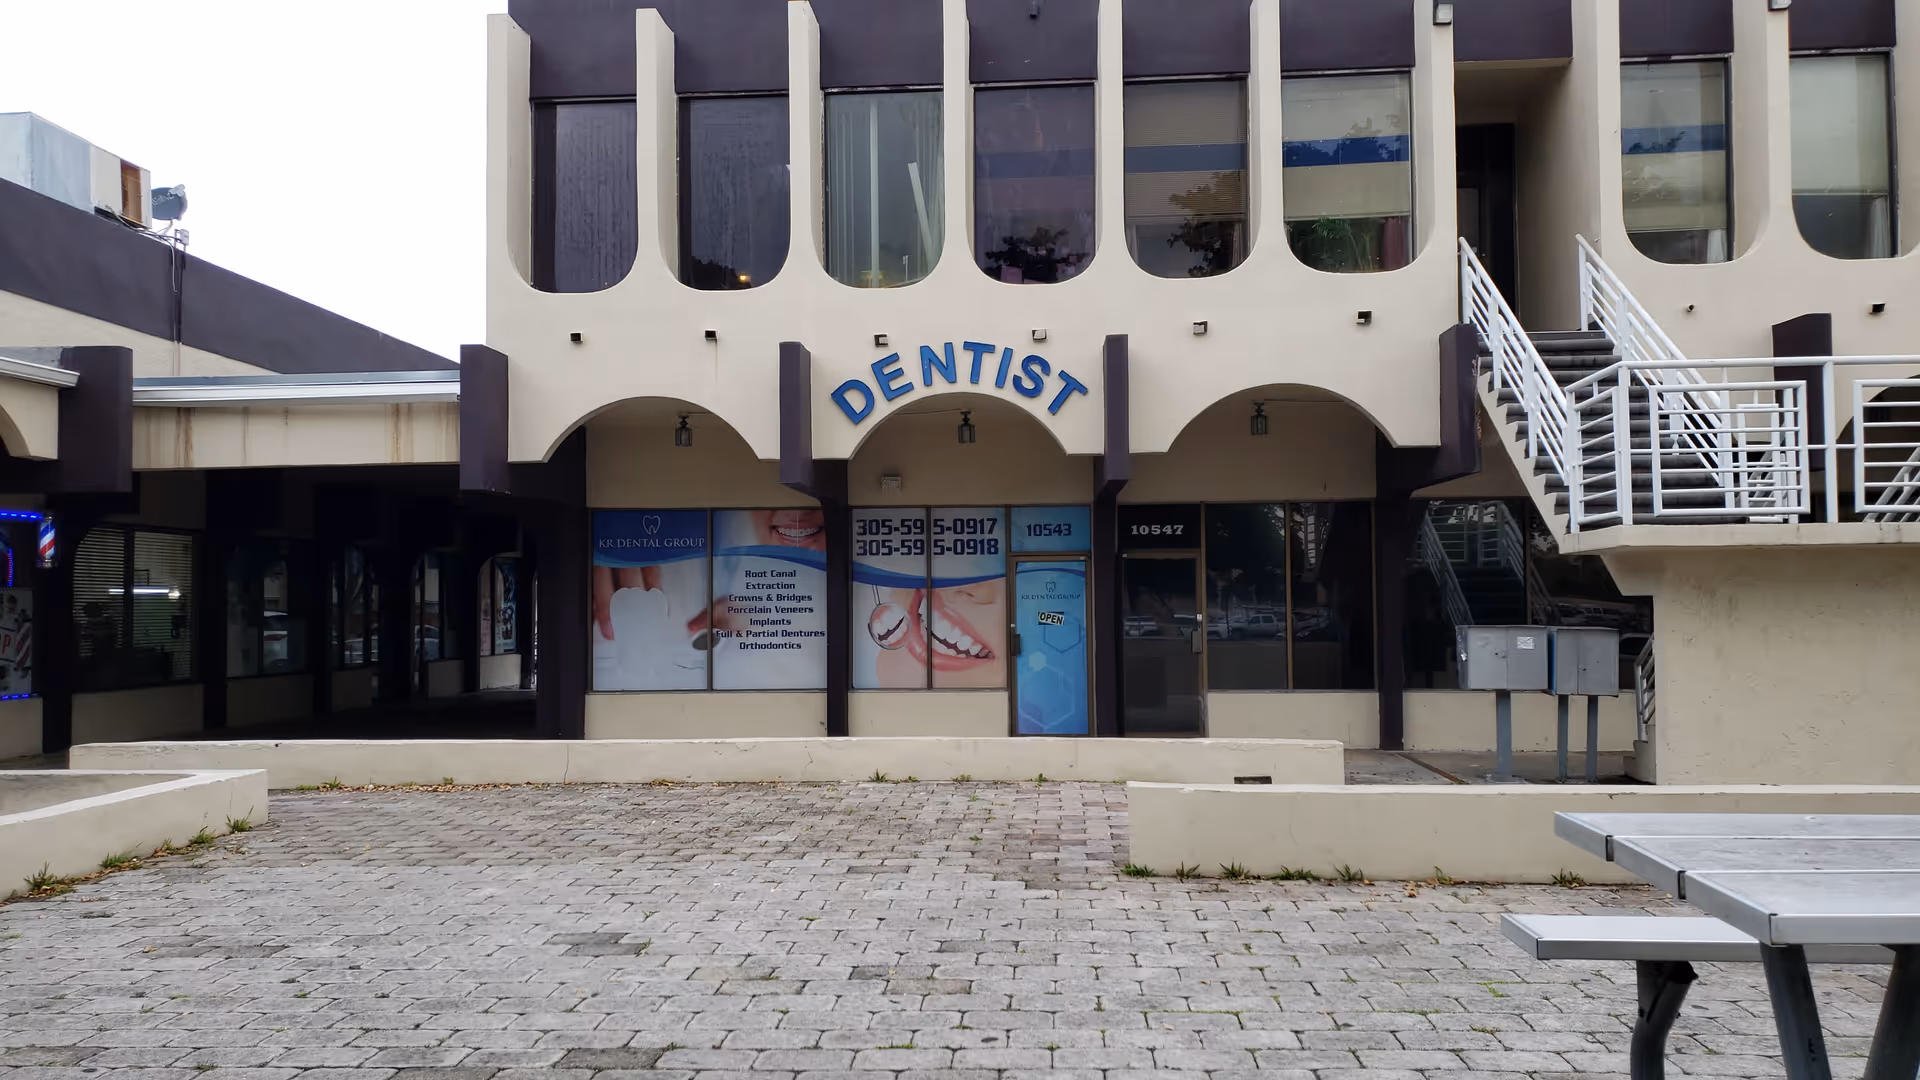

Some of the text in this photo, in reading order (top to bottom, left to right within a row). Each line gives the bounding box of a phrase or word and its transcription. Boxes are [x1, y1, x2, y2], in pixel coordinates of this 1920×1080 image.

[830, 341, 1089, 425] DENTIST
[1026, 523, 1072, 537] 10543
[1131, 525, 1184, 535] 10547
[599, 537, 705, 548] KR DENTAL GROUP
[745, 570, 796, 578] Root Canal
[746, 582, 796, 590] Extraction
[729, 593, 813, 603] Crowns & Bridges
[727, 606, 814, 614] Porcelain Veneers
[750, 618, 791, 627] Implants
[1040, 612, 1064, 625] OPEN
[716, 630, 826, 638] Full & Partial Dentures
[739, 641, 802, 650] Orthodontics
